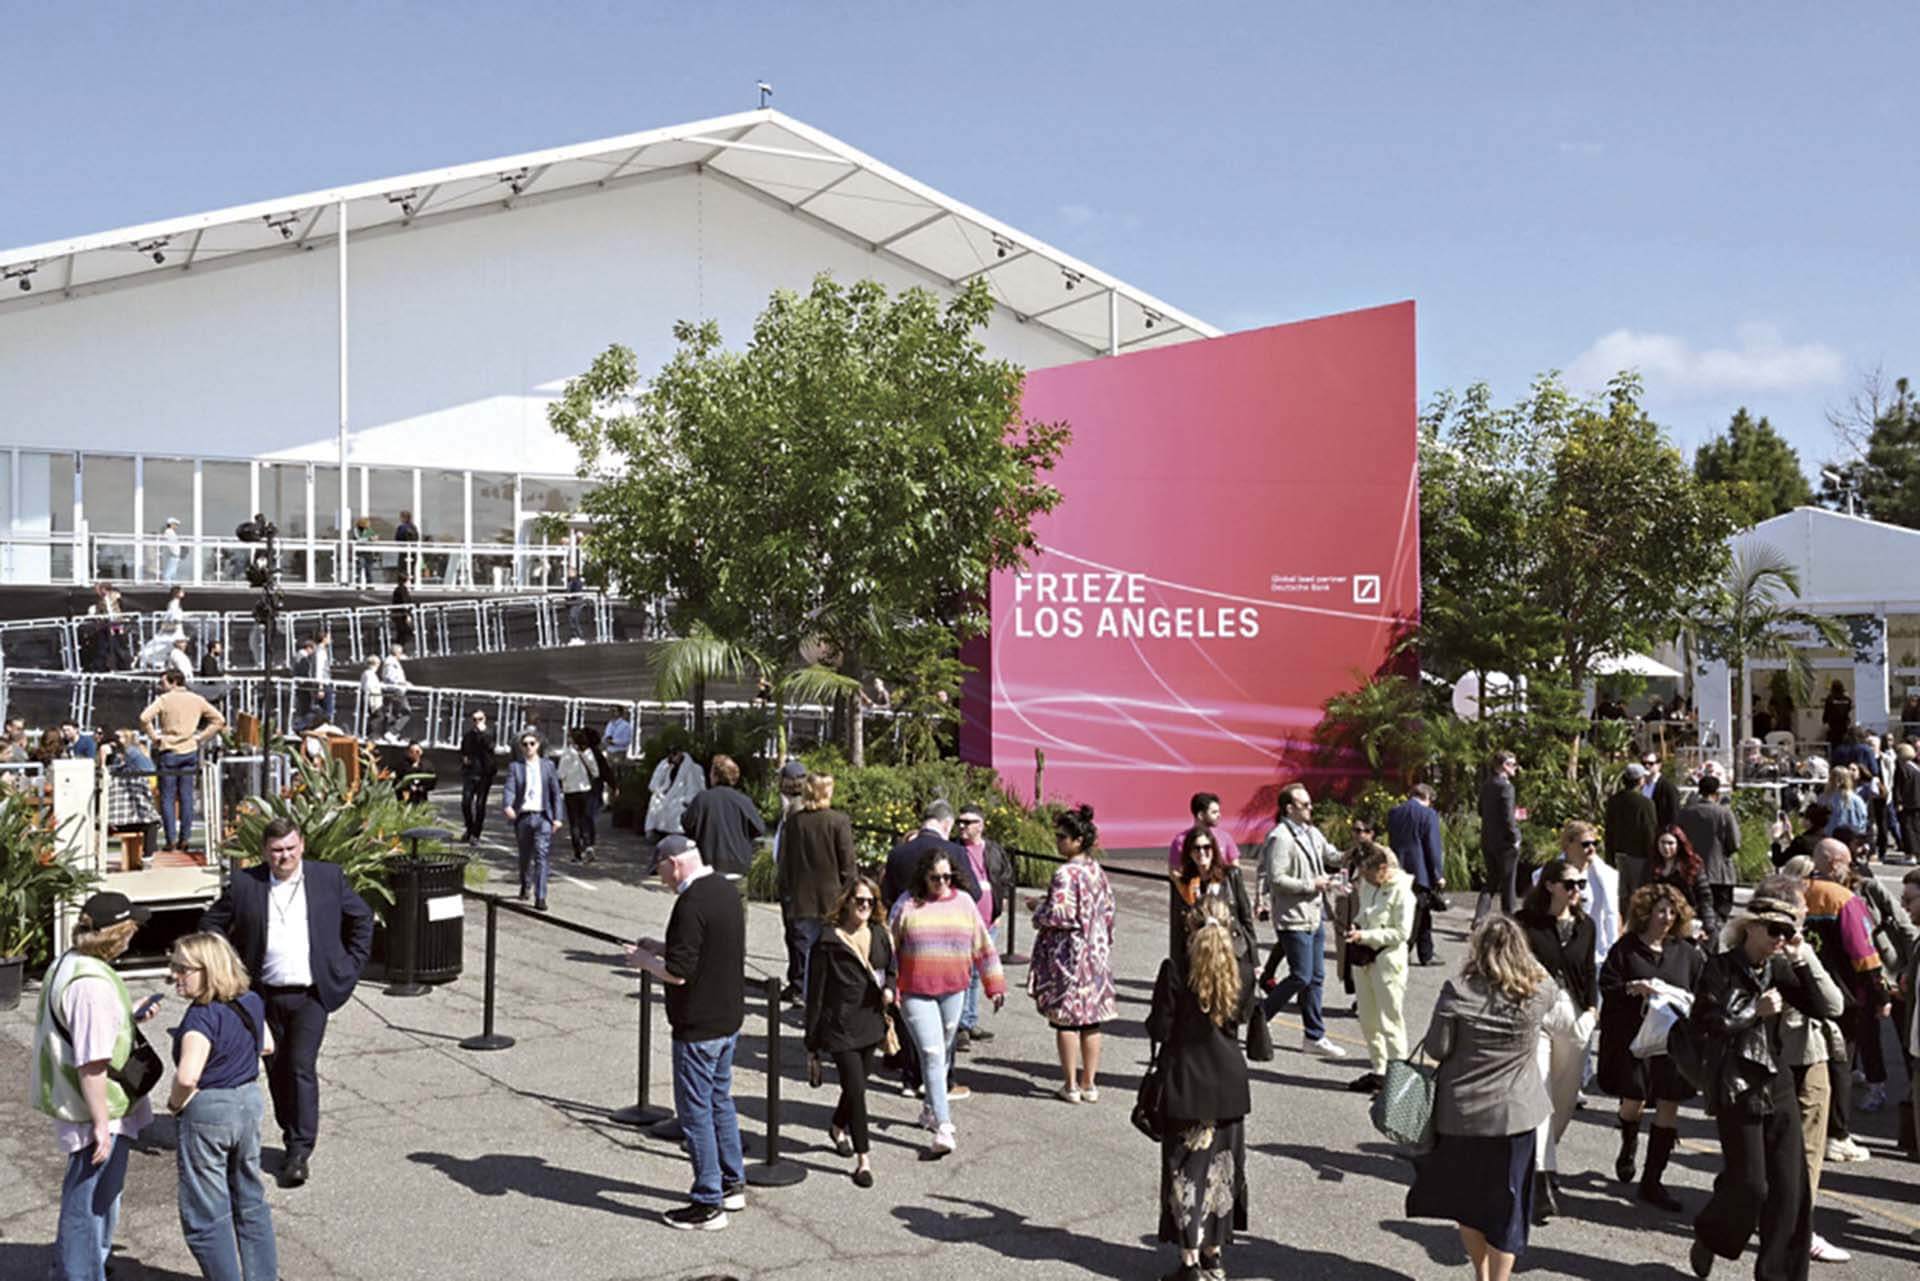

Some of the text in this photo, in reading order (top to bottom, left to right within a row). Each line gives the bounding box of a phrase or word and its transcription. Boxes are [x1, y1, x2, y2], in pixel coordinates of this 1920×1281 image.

[1015, 573, 1146, 603] FRIEZE
[1015, 607, 1259, 637] LOS ANGELES
